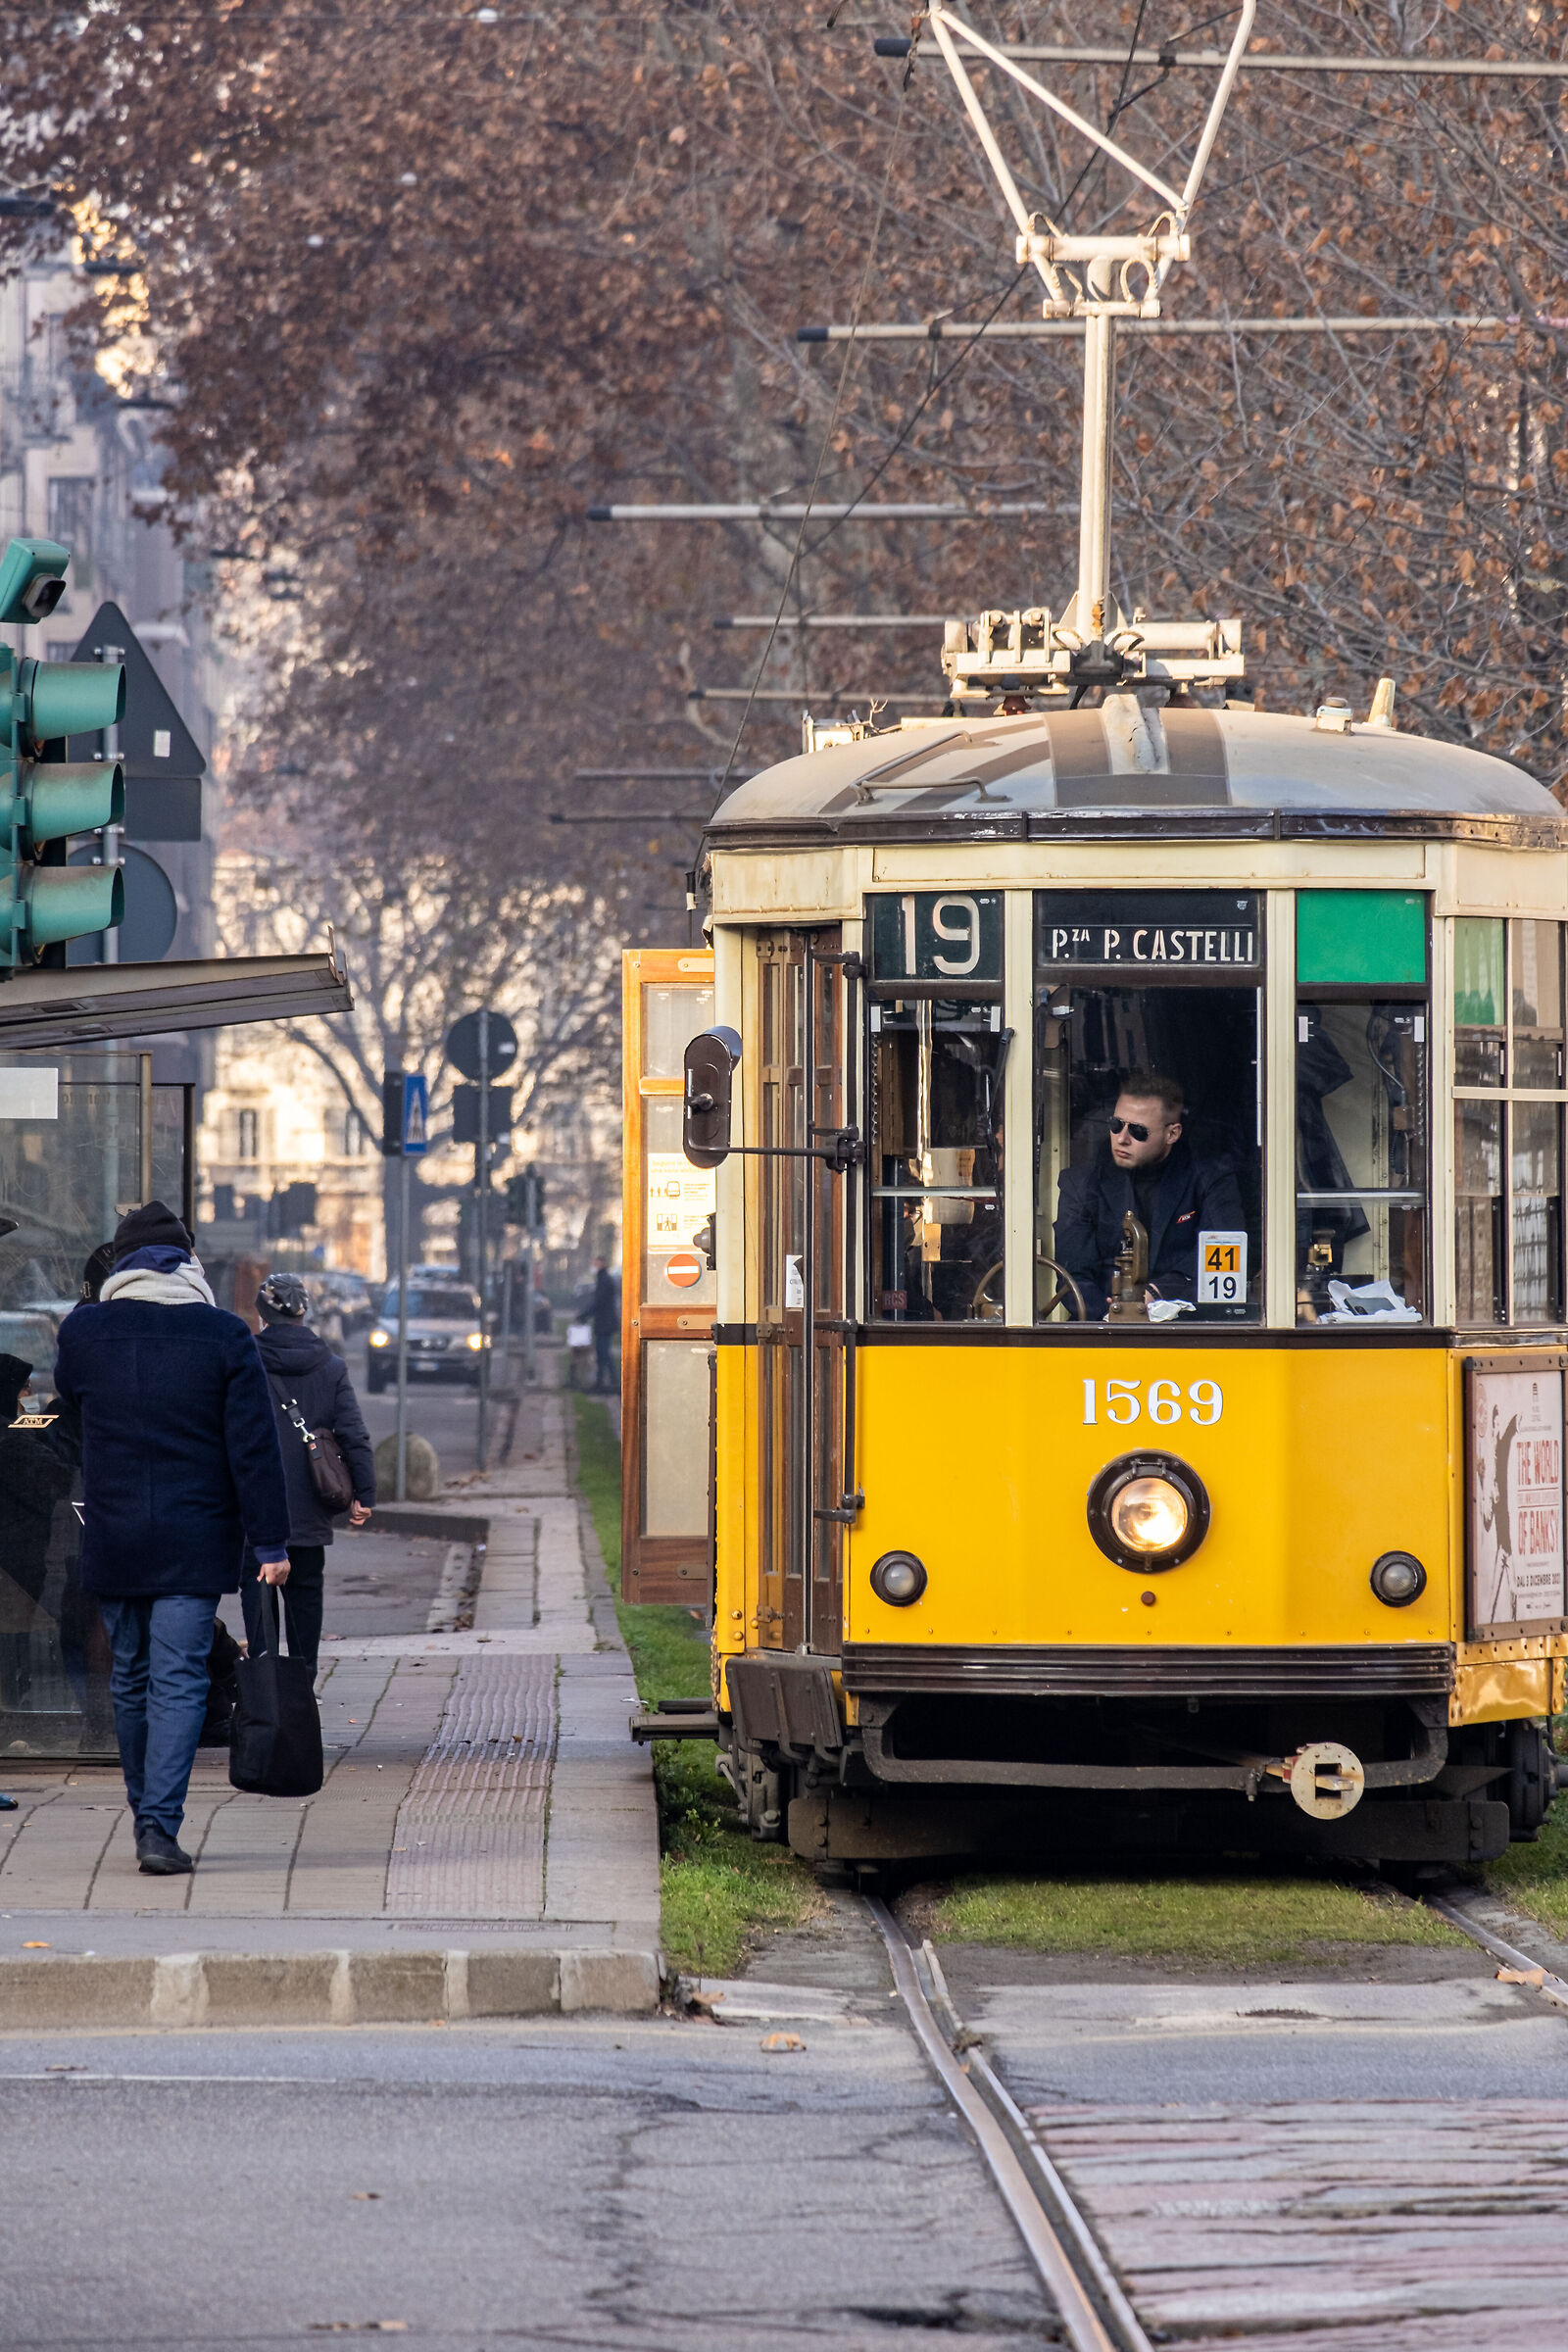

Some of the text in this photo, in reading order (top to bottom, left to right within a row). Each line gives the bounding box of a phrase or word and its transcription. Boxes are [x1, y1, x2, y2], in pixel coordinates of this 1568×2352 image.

[902, 894, 980, 975] 19
[1103, 929, 1121, 959] P.
[1133, 929, 1253, 961] CASTELLI
[1207, 1247, 1235, 1271] 41
[1208, 1276, 1237, 1299] 19
[1082, 1379, 1224, 1425] 1569
[1516, 1439, 1559, 1486] THE WORLD
[1519, 1511, 1528, 1556] OF
